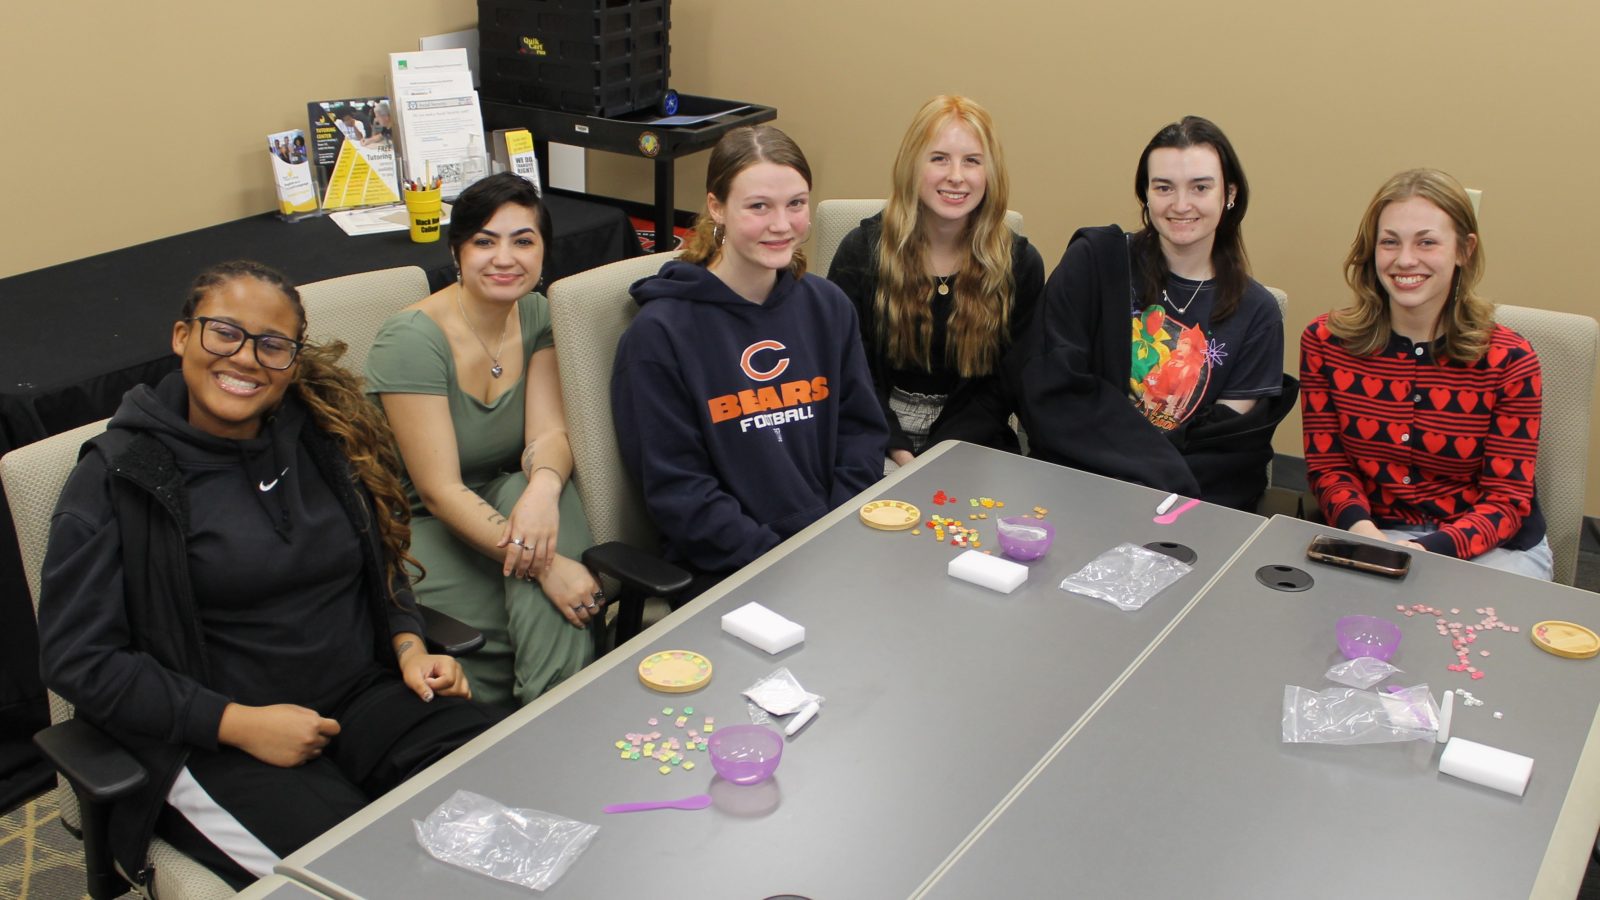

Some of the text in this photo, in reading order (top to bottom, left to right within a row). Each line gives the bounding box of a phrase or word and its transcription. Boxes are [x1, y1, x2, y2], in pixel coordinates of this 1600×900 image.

[367, 153, 393, 161] Tutoring
[415, 218, 431, 226] Black
[740, 340, 790, 381] C
[707, 376, 829, 424] BEARS
